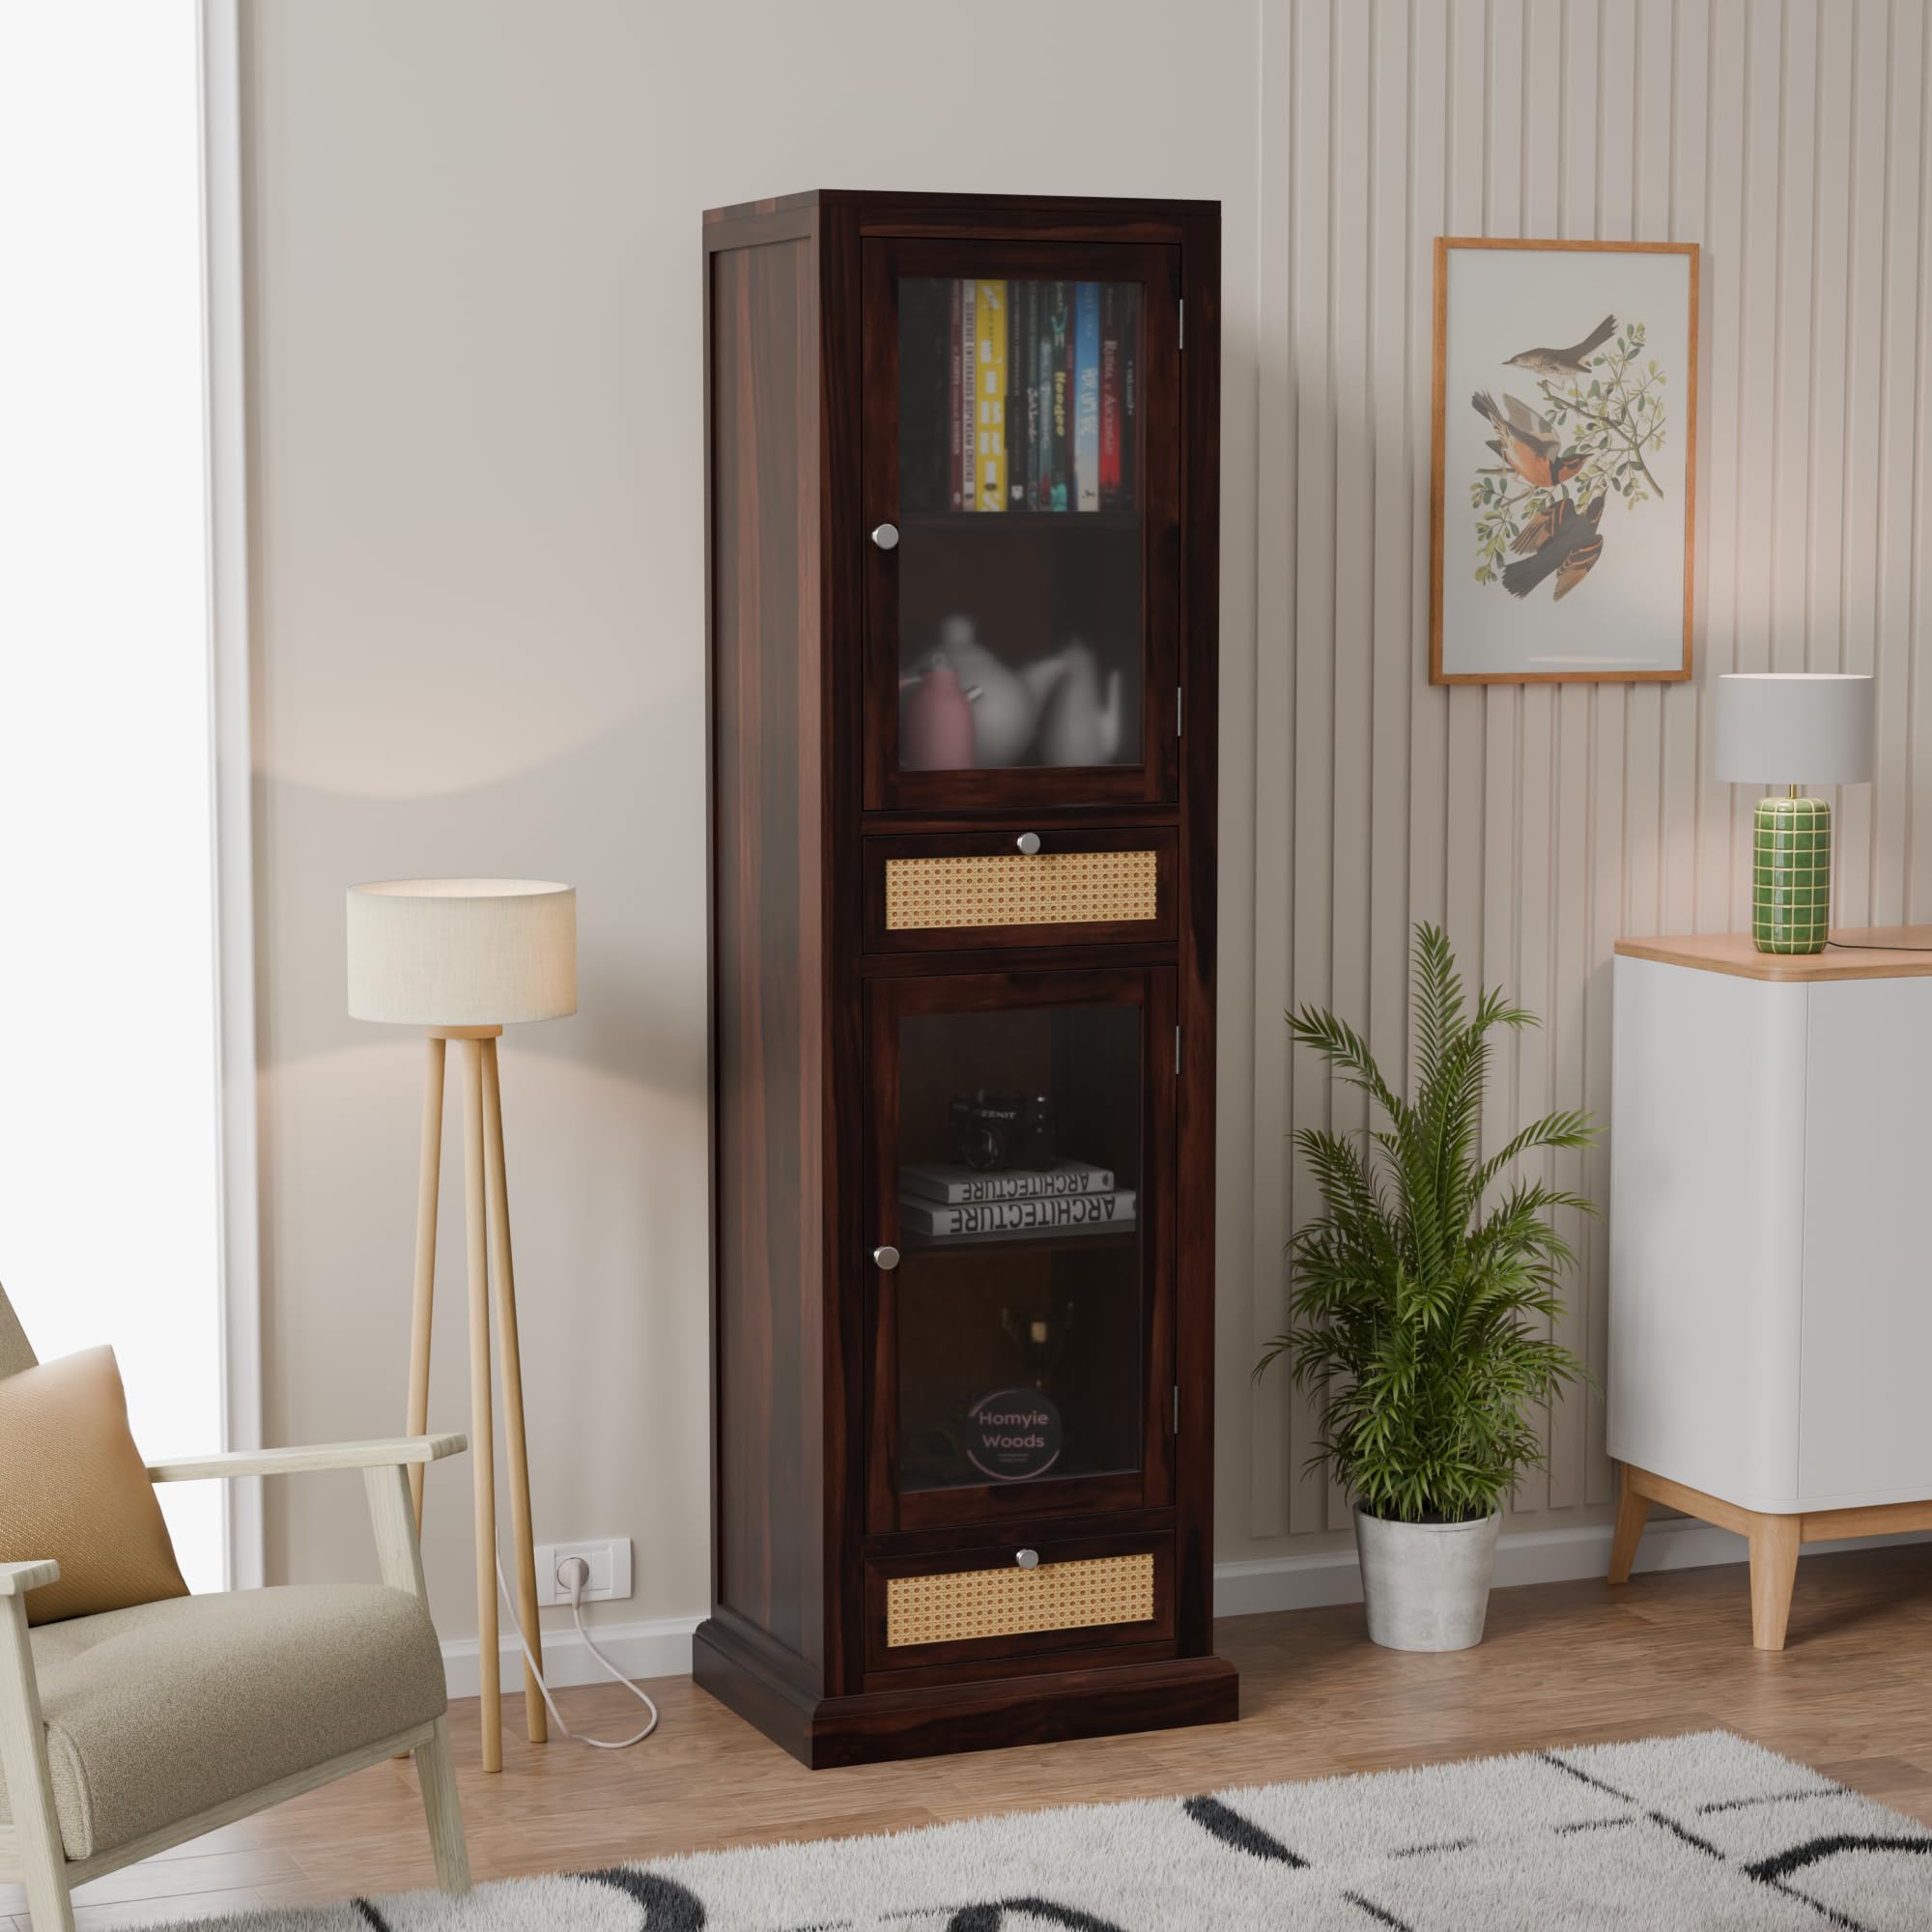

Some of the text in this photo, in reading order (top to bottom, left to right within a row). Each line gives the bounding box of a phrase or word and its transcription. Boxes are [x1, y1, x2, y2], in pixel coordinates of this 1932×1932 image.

[965, 346, 975, 397] ENTERRADOS
[965, 399, 975, 446] DISPENSAM
[965, 448, 975, 483] COVEIRO
[980, 1110, 1016, 1120] ZENIT
[962, 1173, 1090, 1201] ARCHITECTURE
[950, 1196, 1116, 1234] ARCHITECTURE
[979, 1410, 1049, 1428] Homyie
[981, 1434, 1046, 1449] Woods
